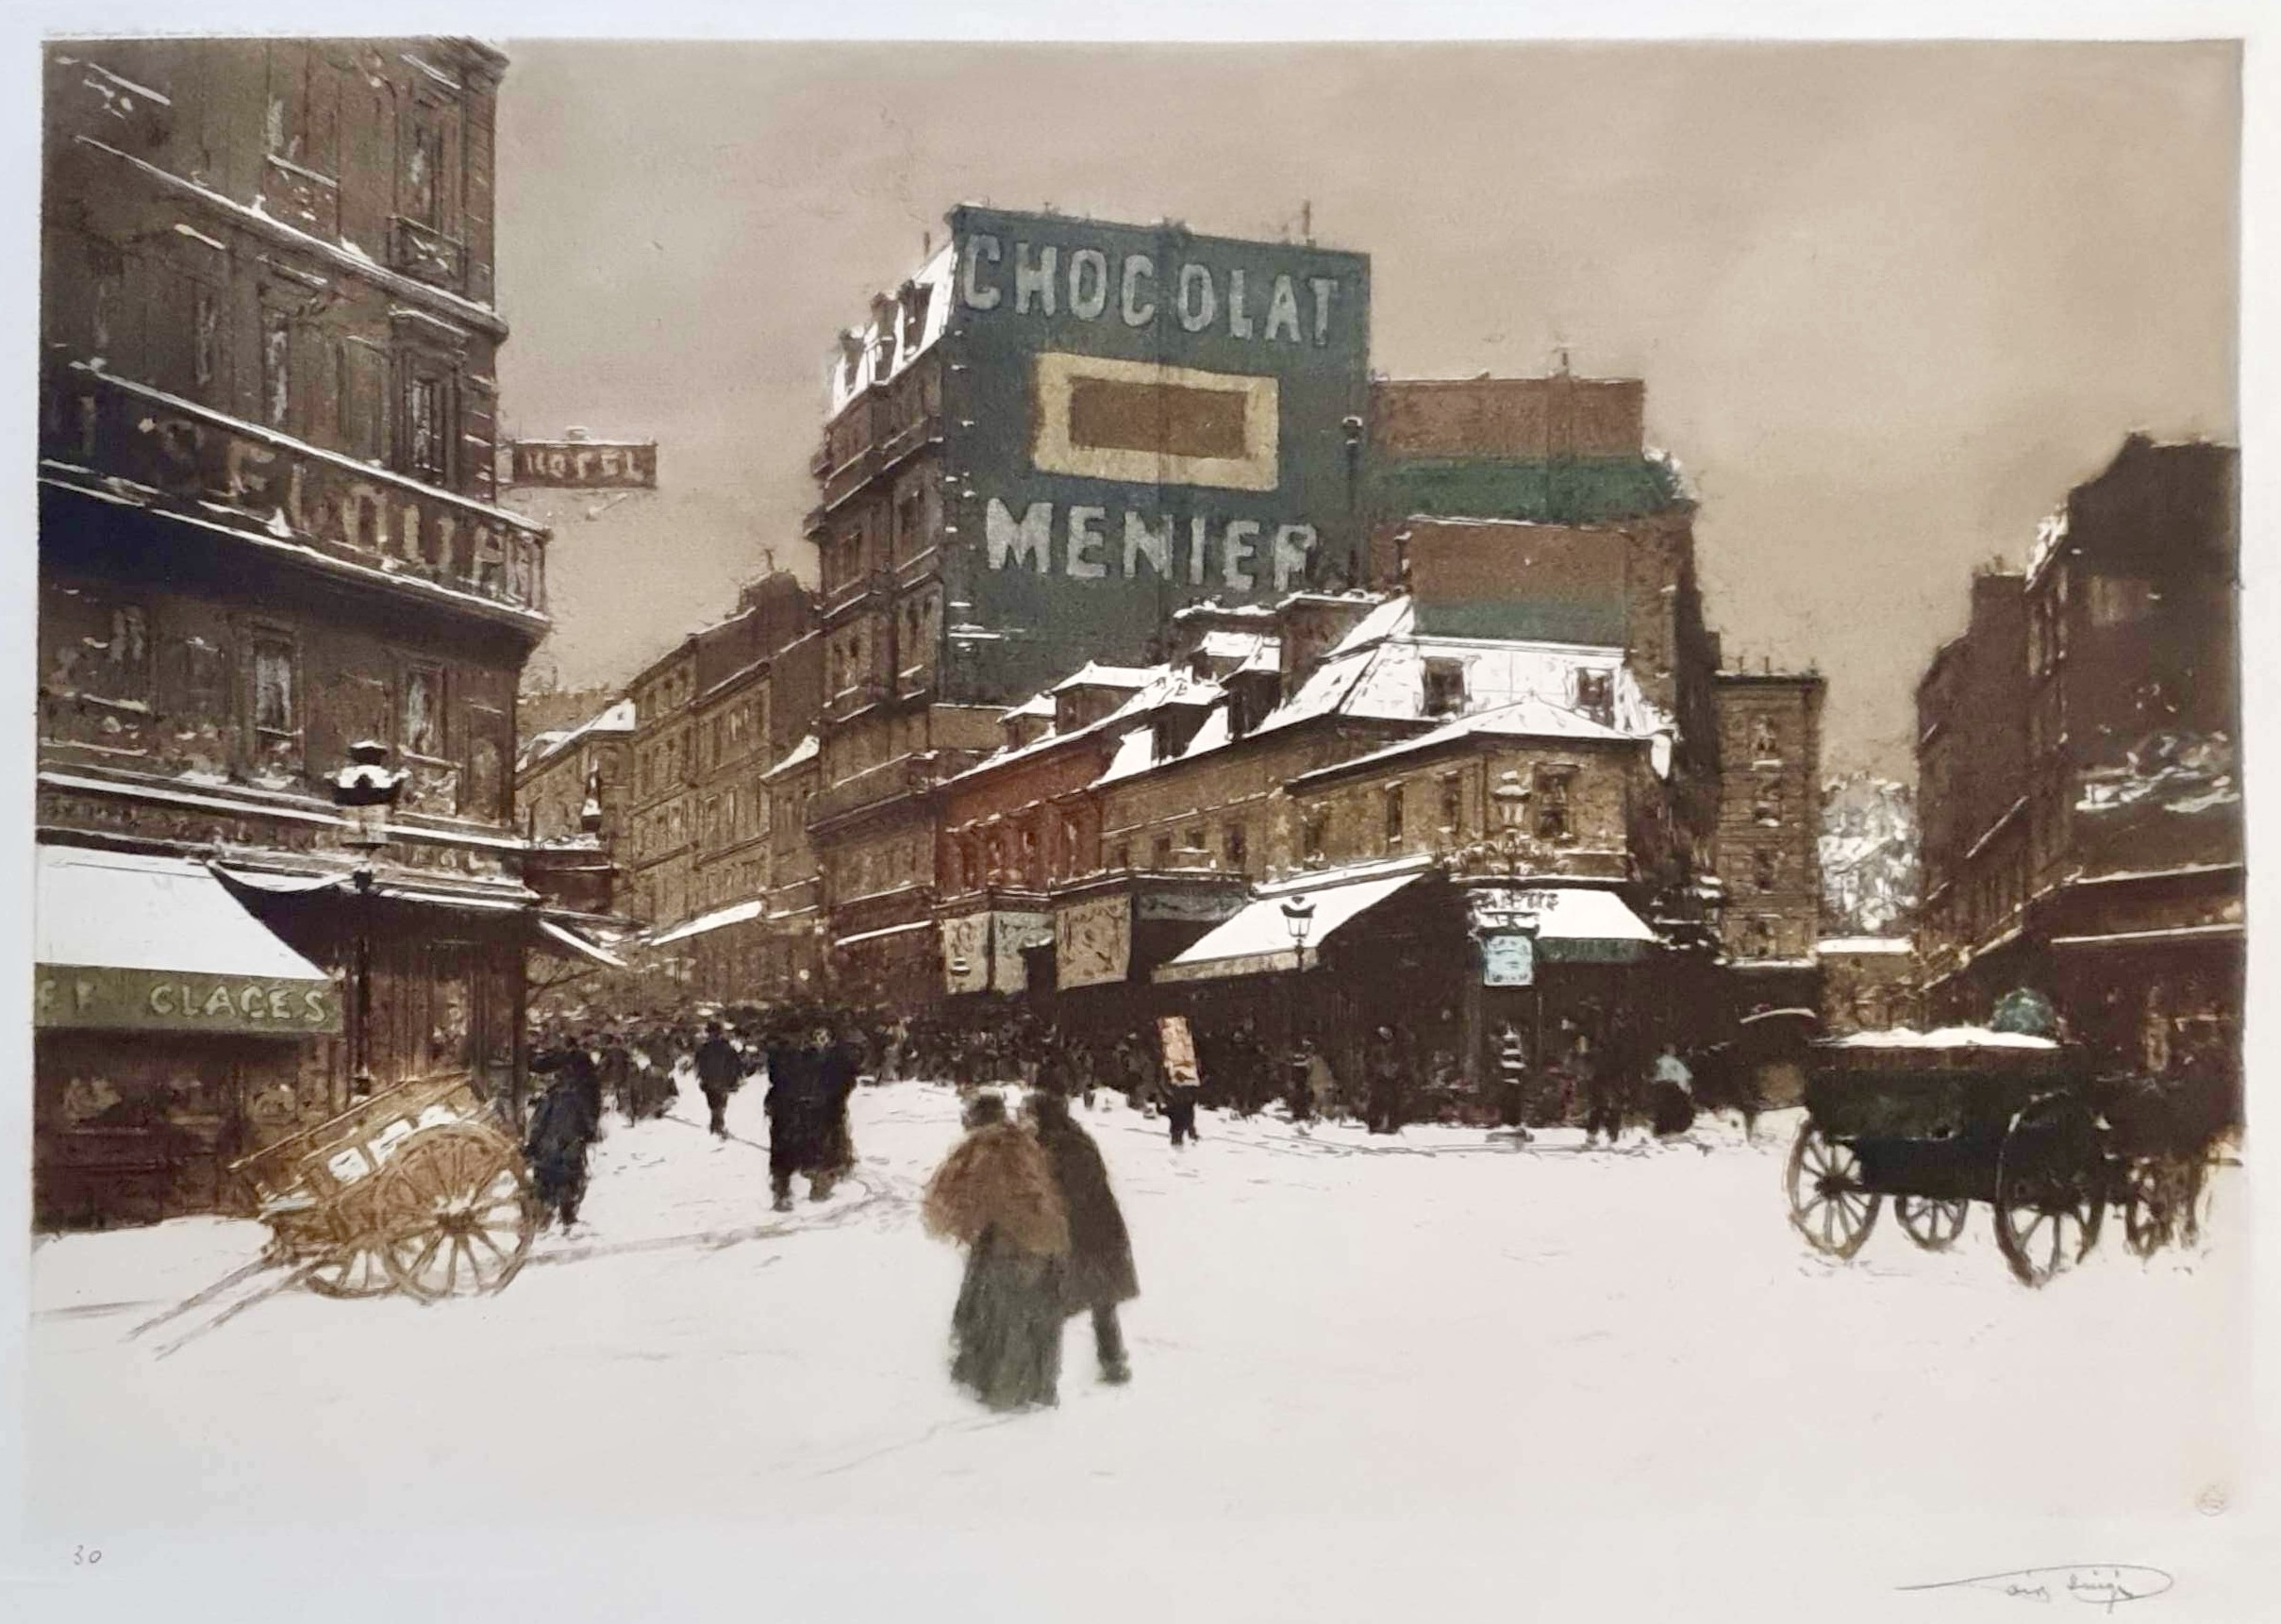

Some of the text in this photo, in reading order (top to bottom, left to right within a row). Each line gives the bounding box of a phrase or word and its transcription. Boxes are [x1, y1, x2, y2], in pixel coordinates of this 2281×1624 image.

[962, 233, 1340, 347] CHOCOLAT
[986, 496, 1318, 593] MENIER
[73, 1544, 103, 1566] 30
